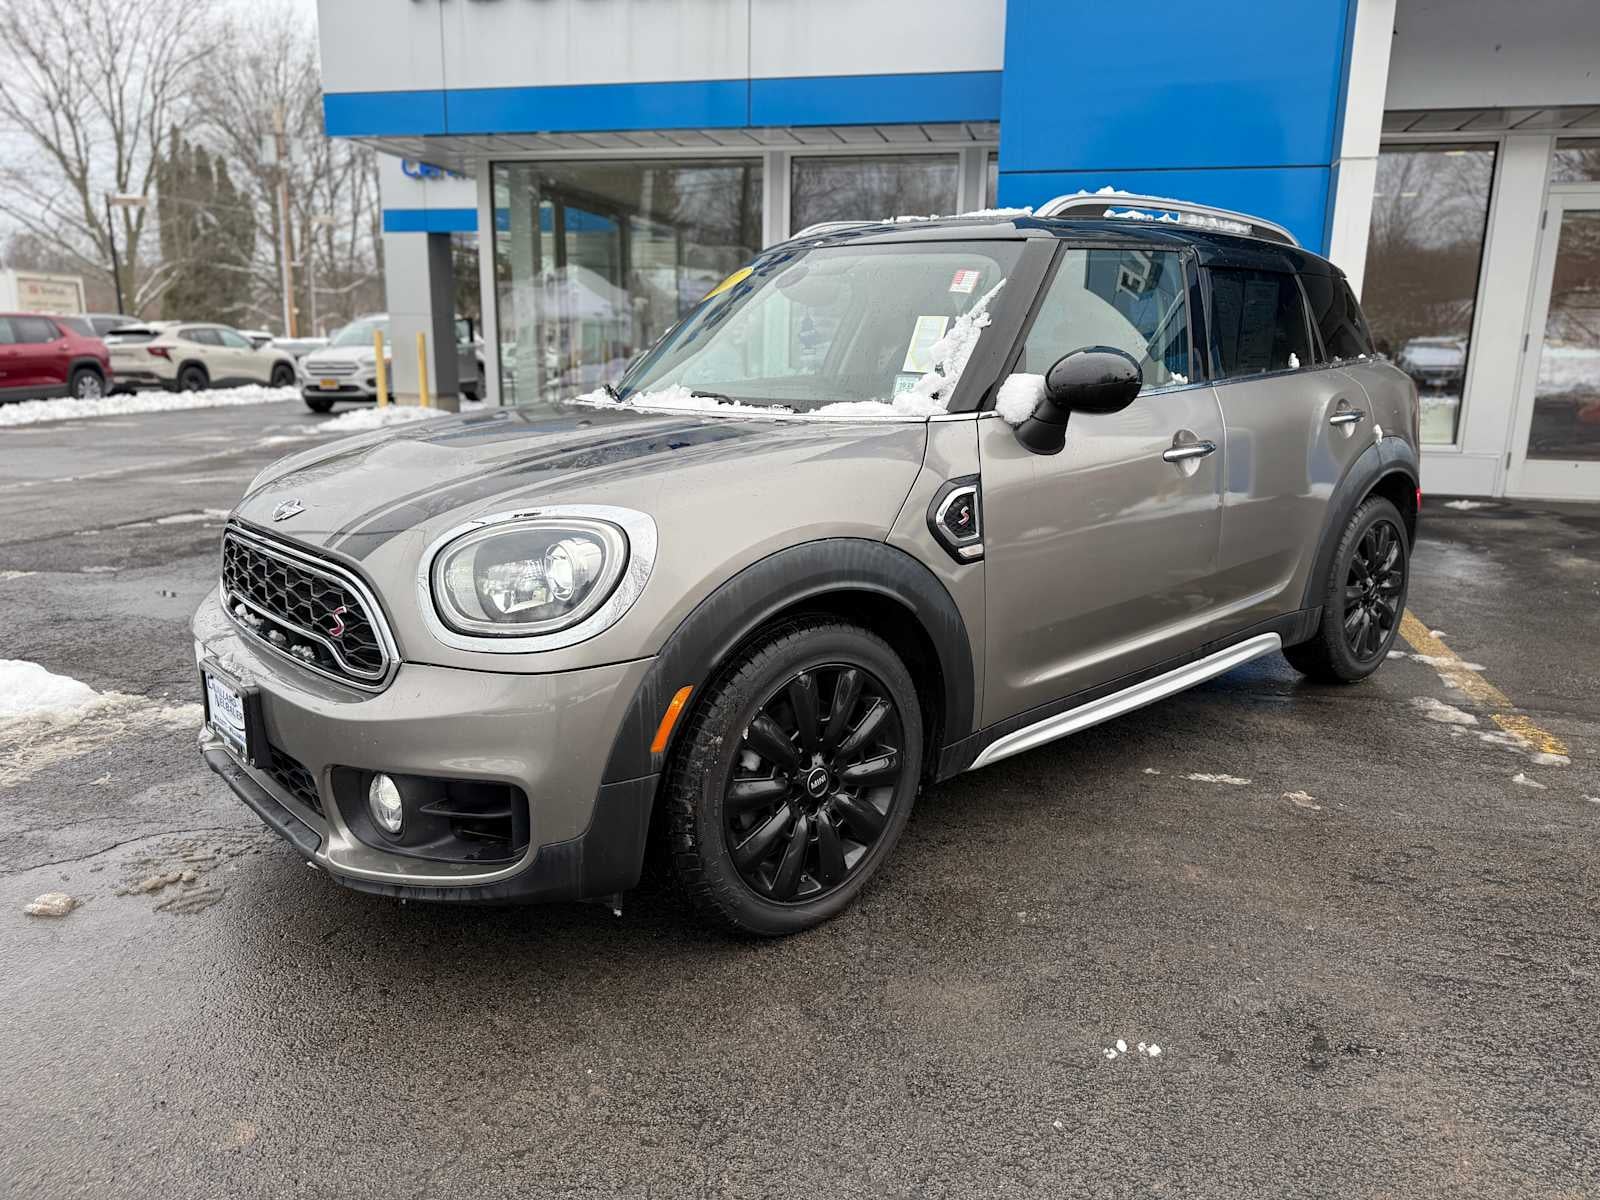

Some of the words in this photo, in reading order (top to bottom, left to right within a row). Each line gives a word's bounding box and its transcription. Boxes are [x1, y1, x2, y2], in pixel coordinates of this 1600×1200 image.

[957, 506, 970, 527] S
[328, 606, 347, 637] S
[811, 774, 827, 789] MINI
